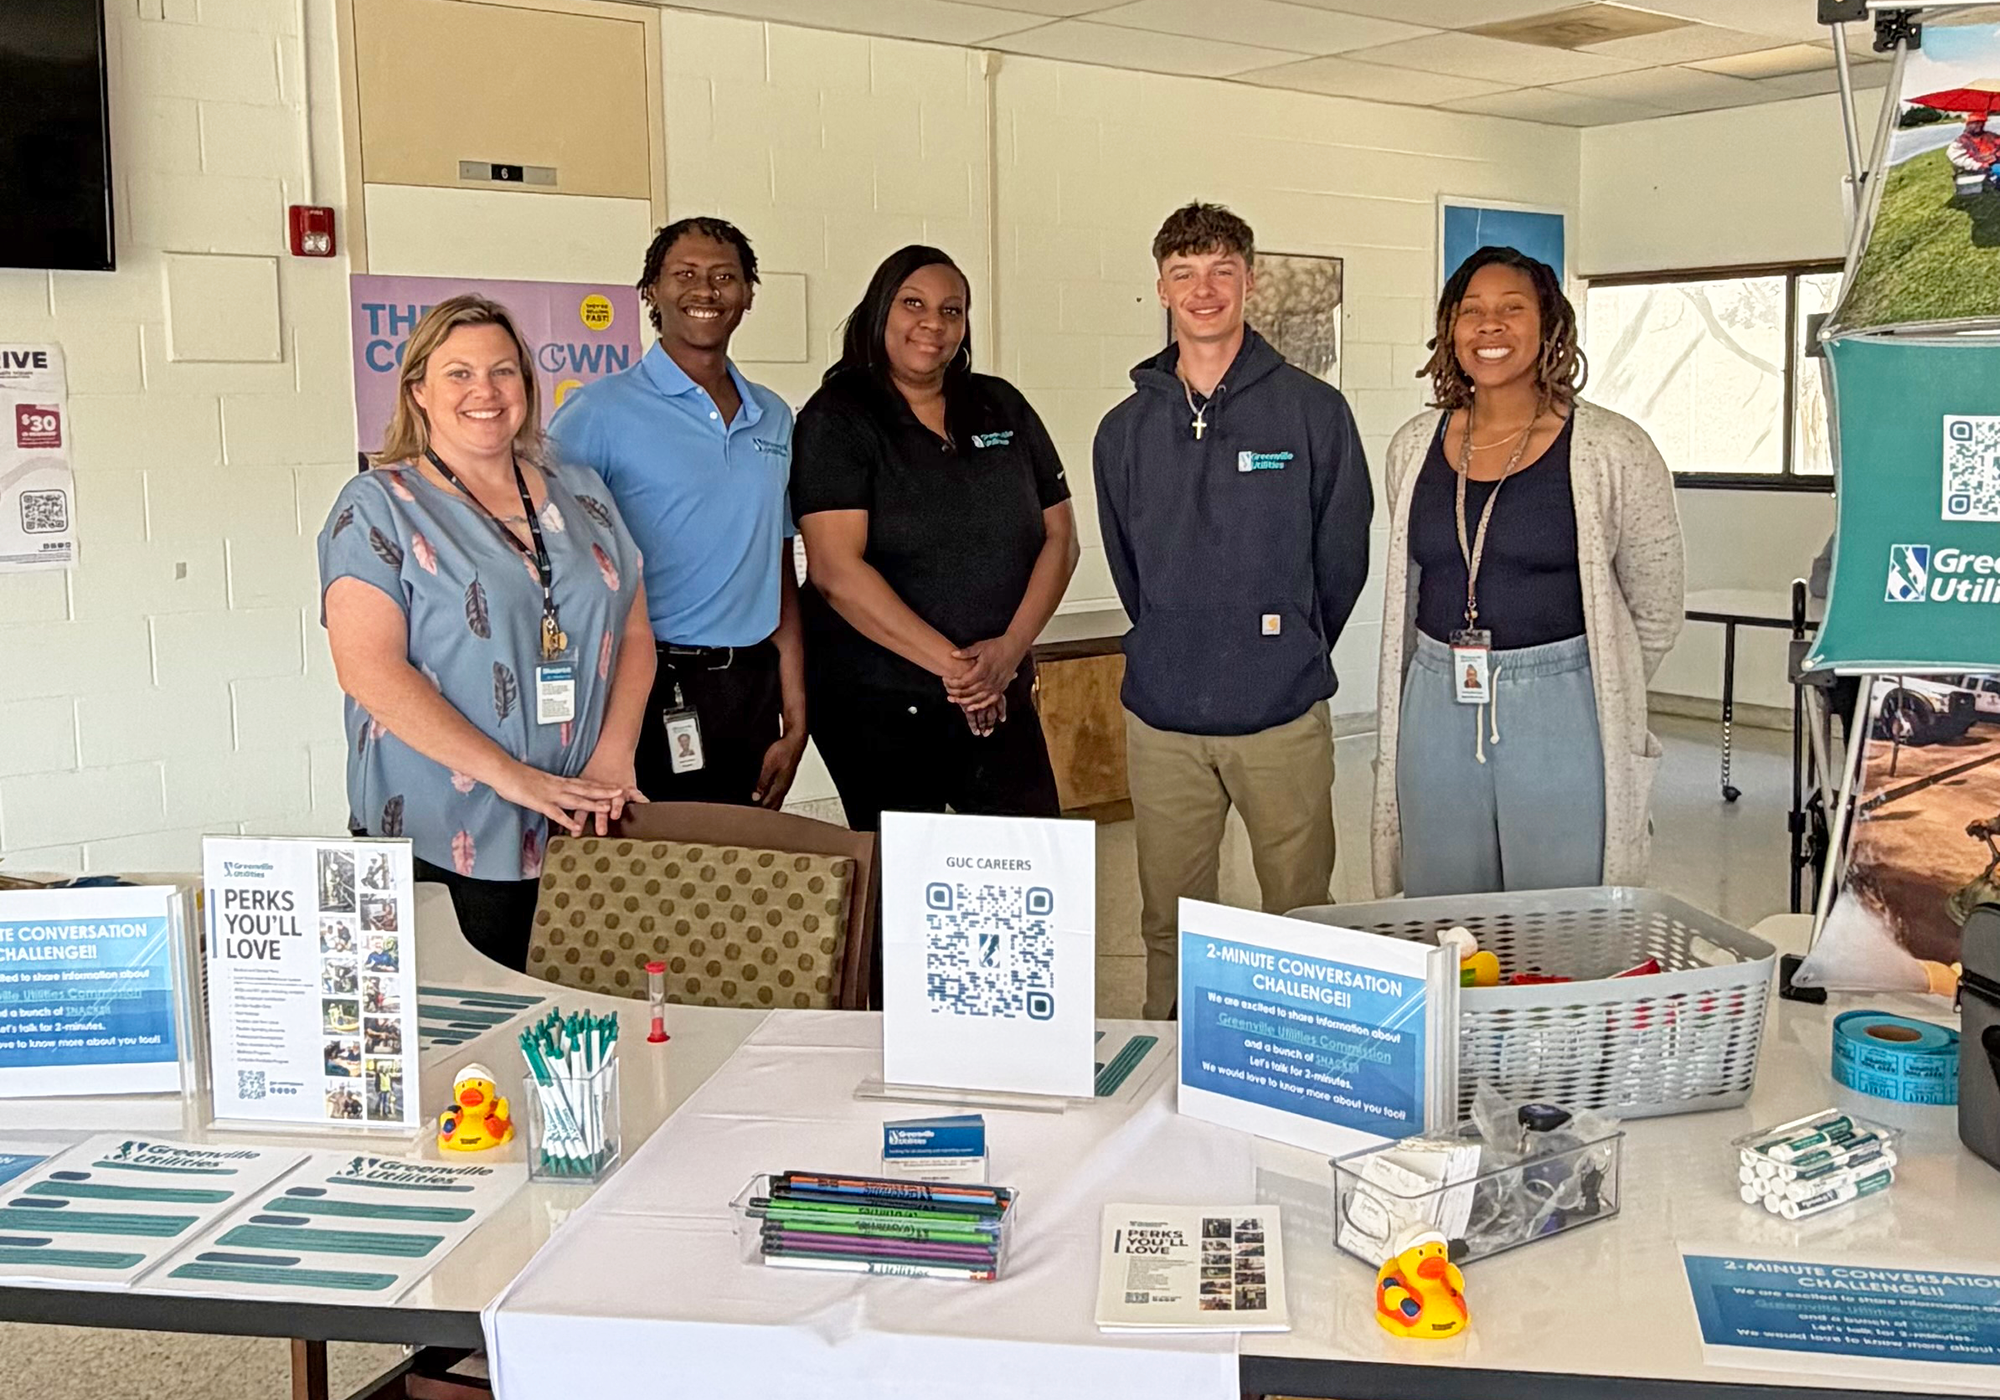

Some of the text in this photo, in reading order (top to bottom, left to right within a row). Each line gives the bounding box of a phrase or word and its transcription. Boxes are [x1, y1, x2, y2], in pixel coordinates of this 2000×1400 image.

[500, 167, 509, 179] 6
[0, 351, 48, 369] IVE
[21, 413, 56, 431] $30
[1930, 577, 2000, 603] Utili
[946, 857, 1032, 871] GUC CAREERS
[225, 888, 294, 912] PERKS
[18, 923, 148, 942] CONVERSATION
[224, 913, 302, 936] YOU'LL
[226, 938, 281, 960] LOVE
[20, 973, 31, 982] to
[32, 972, 61, 982] share
[62, 971, 118, 980] information
[120, 969, 150, 979] about
[1206, 943, 1402, 998] 2-MINUTE CONVERSATION
[23, 989, 65, 1000] Utilities
[68, 987, 142, 1000] Commission
[1252, 973, 1351, 1009] CHALLENGE!!
[19, 1006, 51, 1017] bunch
[53, 1006, 64, 1016] of
[1208, 992, 1401, 1044] We are excited to share information about
[0, 1024, 17, 1034] et's
[19, 1023, 38, 1033] talk
[39, 1023, 53, 1032] for
[1218, 1012, 1392, 1062] Greenville Utilities Commission
[17, 1041, 27, 1049] to
[29, 1039, 56, 1049] know
[58, 1039, 84, 1048] more
[86, 1037, 116, 1046] about
[118, 1037, 137, 1047] you
[1244, 1038, 1263, 1050] and
[1264, 1044, 1271, 1052] a
[1273, 1043, 1303, 1060] bunch
[1304, 1053, 1314, 1062] of
[1250, 1056, 1353, 1090] Let's talk for 2-minutes.
[1202, 1061, 1216, 1073] We
[1218, 1066, 1245, 1080] would
[1246, 1072, 1267, 1085] love
[1268, 1077, 1278, 1088] to
[1279, 1080, 1304, 1095] know
[1306, 1088, 1331, 1101] more
[1333, 1094, 1362, 1109] about
[1363, 1103, 1382, 1115] you
[133, 1154, 224, 1167] Utilities
[147, 1145, 261, 1160] Greenville
[379, 1160, 494, 1176] Greenville
[366, 1170, 458, 1184] Utilities
[1128, 1229, 1183, 1238] PERKS
[1126, 1246, 1170, 1254] LOVE
[1127, 1238, 1188, 1247] YOU'LL
[1724, 1260, 1826, 1276] 2-MINUTE
[1797, 1277, 1945, 1297] CHALLENGE!!
[1733, 1287, 1755, 1295] We
[1785, 1291, 1838, 1301] excited
[1858, 1296, 1896, 1305] share
[1899, 1299, 1980, 1311] information
[1798, 1313, 1827, 1322] and
[1844, 1316, 1890, 1327] bunch
[1894, 1320, 1907, 1328] of
[1846, 1326, 1874, 1335] talk
[1876, 1328, 1895, 1337] for
[1736, 1328, 1760, 1336] We
[1763, 1331, 1807, 1340] would
[1810, 1333, 1842, 1343] love
[1845, 1336, 1860, 1344] to
[1863, 1337, 1903, 1347] know
[1907, 1341, 1946, 1351] more
[1950, 1344, 1994, 1353] about
